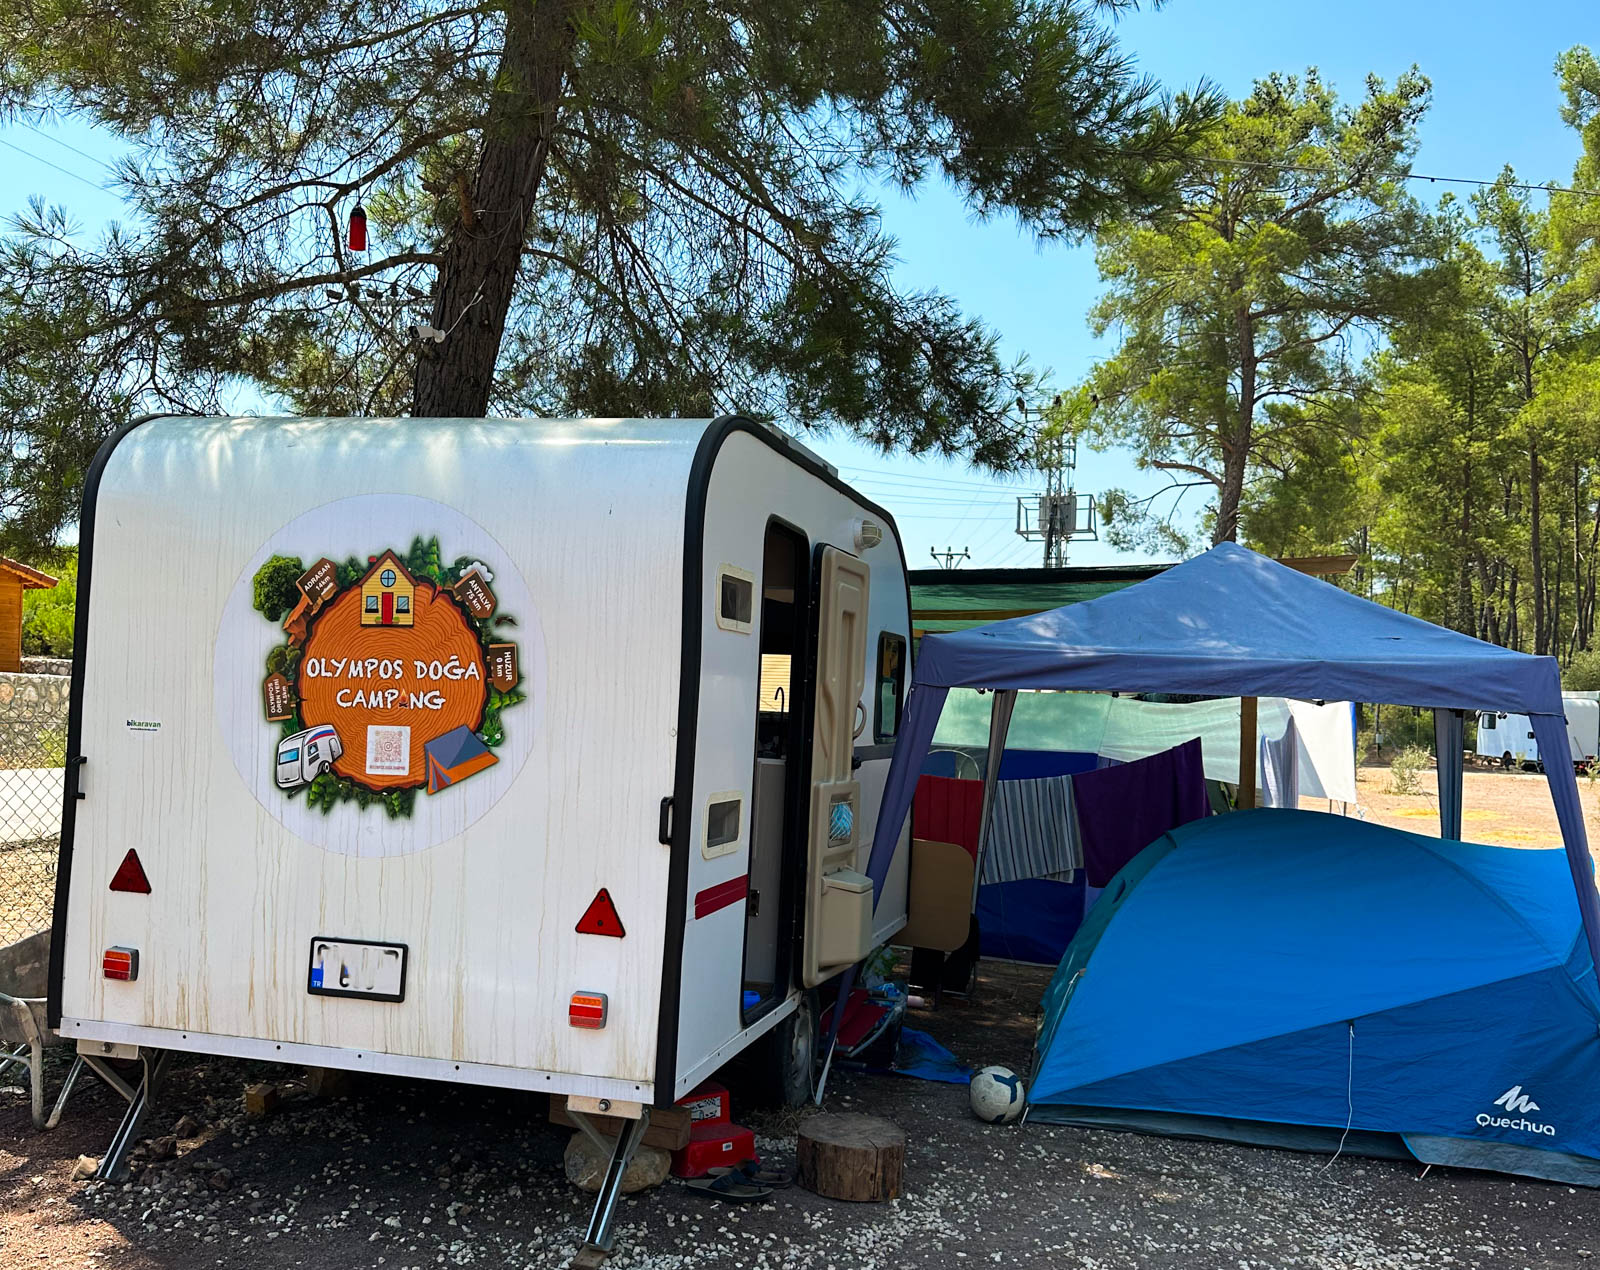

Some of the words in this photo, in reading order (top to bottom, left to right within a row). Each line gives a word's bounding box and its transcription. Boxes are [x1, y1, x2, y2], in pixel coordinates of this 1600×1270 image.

[304, 563, 331, 592] ADRASAN
[315, 575, 331, 591] 14km
[466, 589, 476, 600] 75
[472, 598, 482, 611] km
[469, 579, 492, 611] ANTALYA
[306, 657, 404, 680] OLYMPOS
[413, 655, 480, 681] DOĞA
[496, 664, 503, 677] km
[504, 651, 513, 682] HUZUR
[268, 682, 276, 714] OLYMPOS
[126, 719, 161, 728] bikaravan
[1475, 1113, 1556, 1137] Quechua
